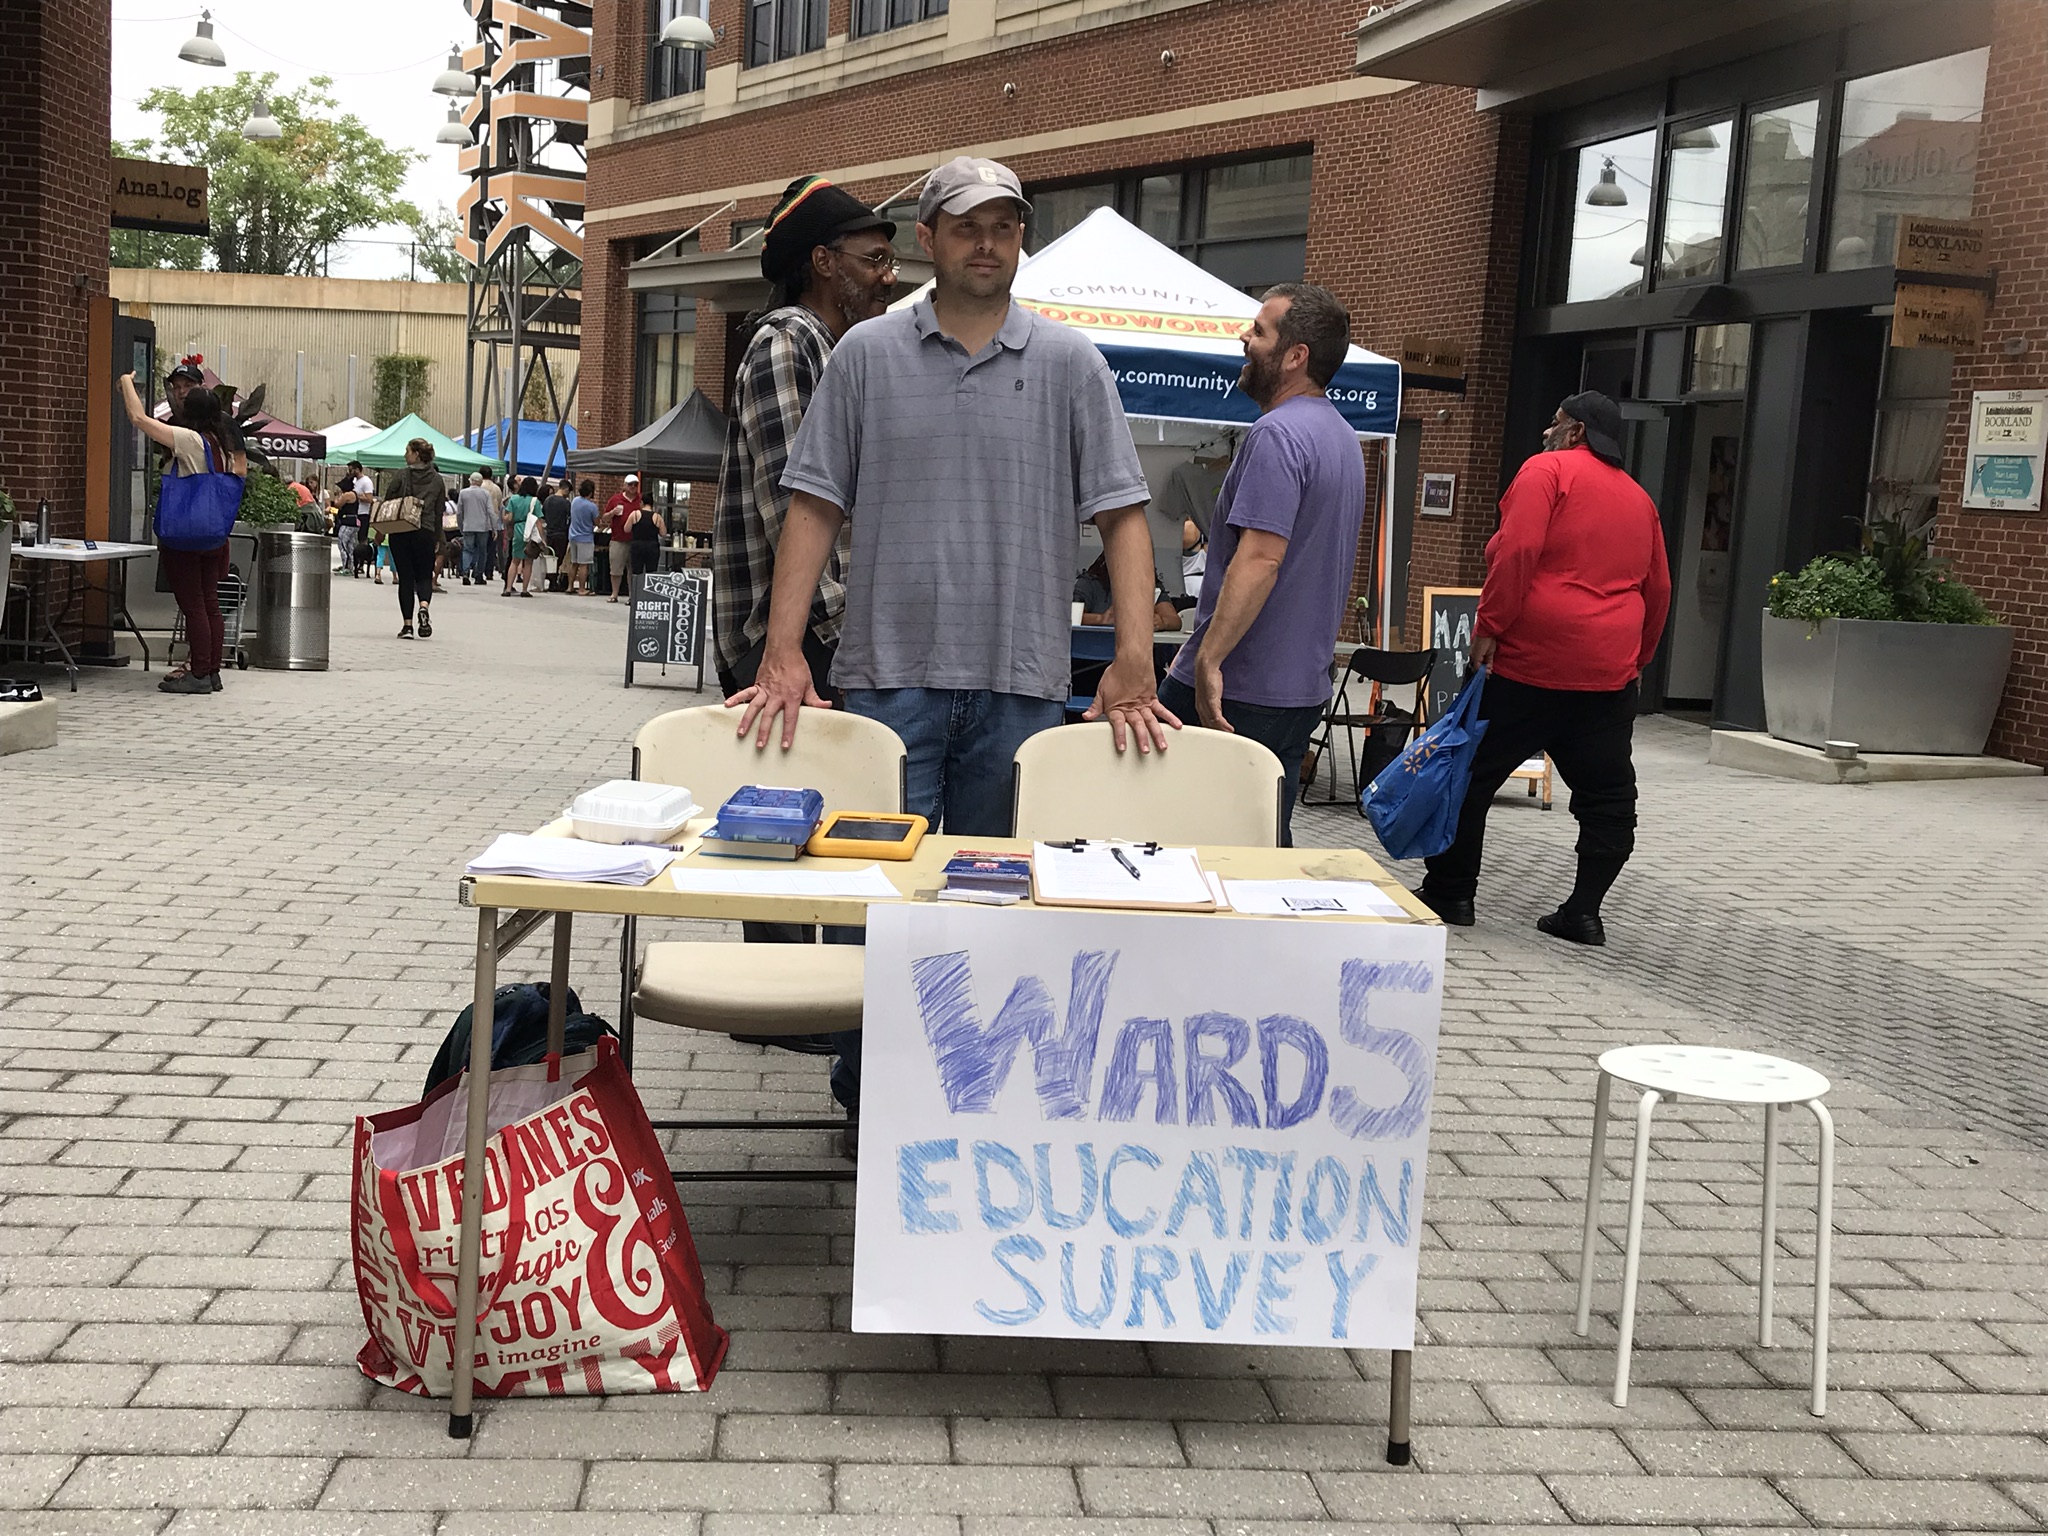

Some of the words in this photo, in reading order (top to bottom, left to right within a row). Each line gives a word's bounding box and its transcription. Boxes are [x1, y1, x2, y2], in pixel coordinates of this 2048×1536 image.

[116, 176, 203, 209] Analog
[1908, 234, 1983, 253] BOOKLAND
[1050, 285, 1219, 309] COMMUNITY
[1021, 304, 1254, 335] OODWORK
[1984, 416, 2033, 427] BOOKLAND
[247, 436, 310, 453] SONS
[635, 610, 670, 620] PROPER
[637, 601, 670, 611] RIGHT
[640, 641, 658, 654] DC
[896, 1137, 1414, 1247] EDUCATION
[973, 1233, 1382, 1340] SURVEY
[490, 1276, 583, 1345] JOY
[497, 1334, 601, 1366] imagine
